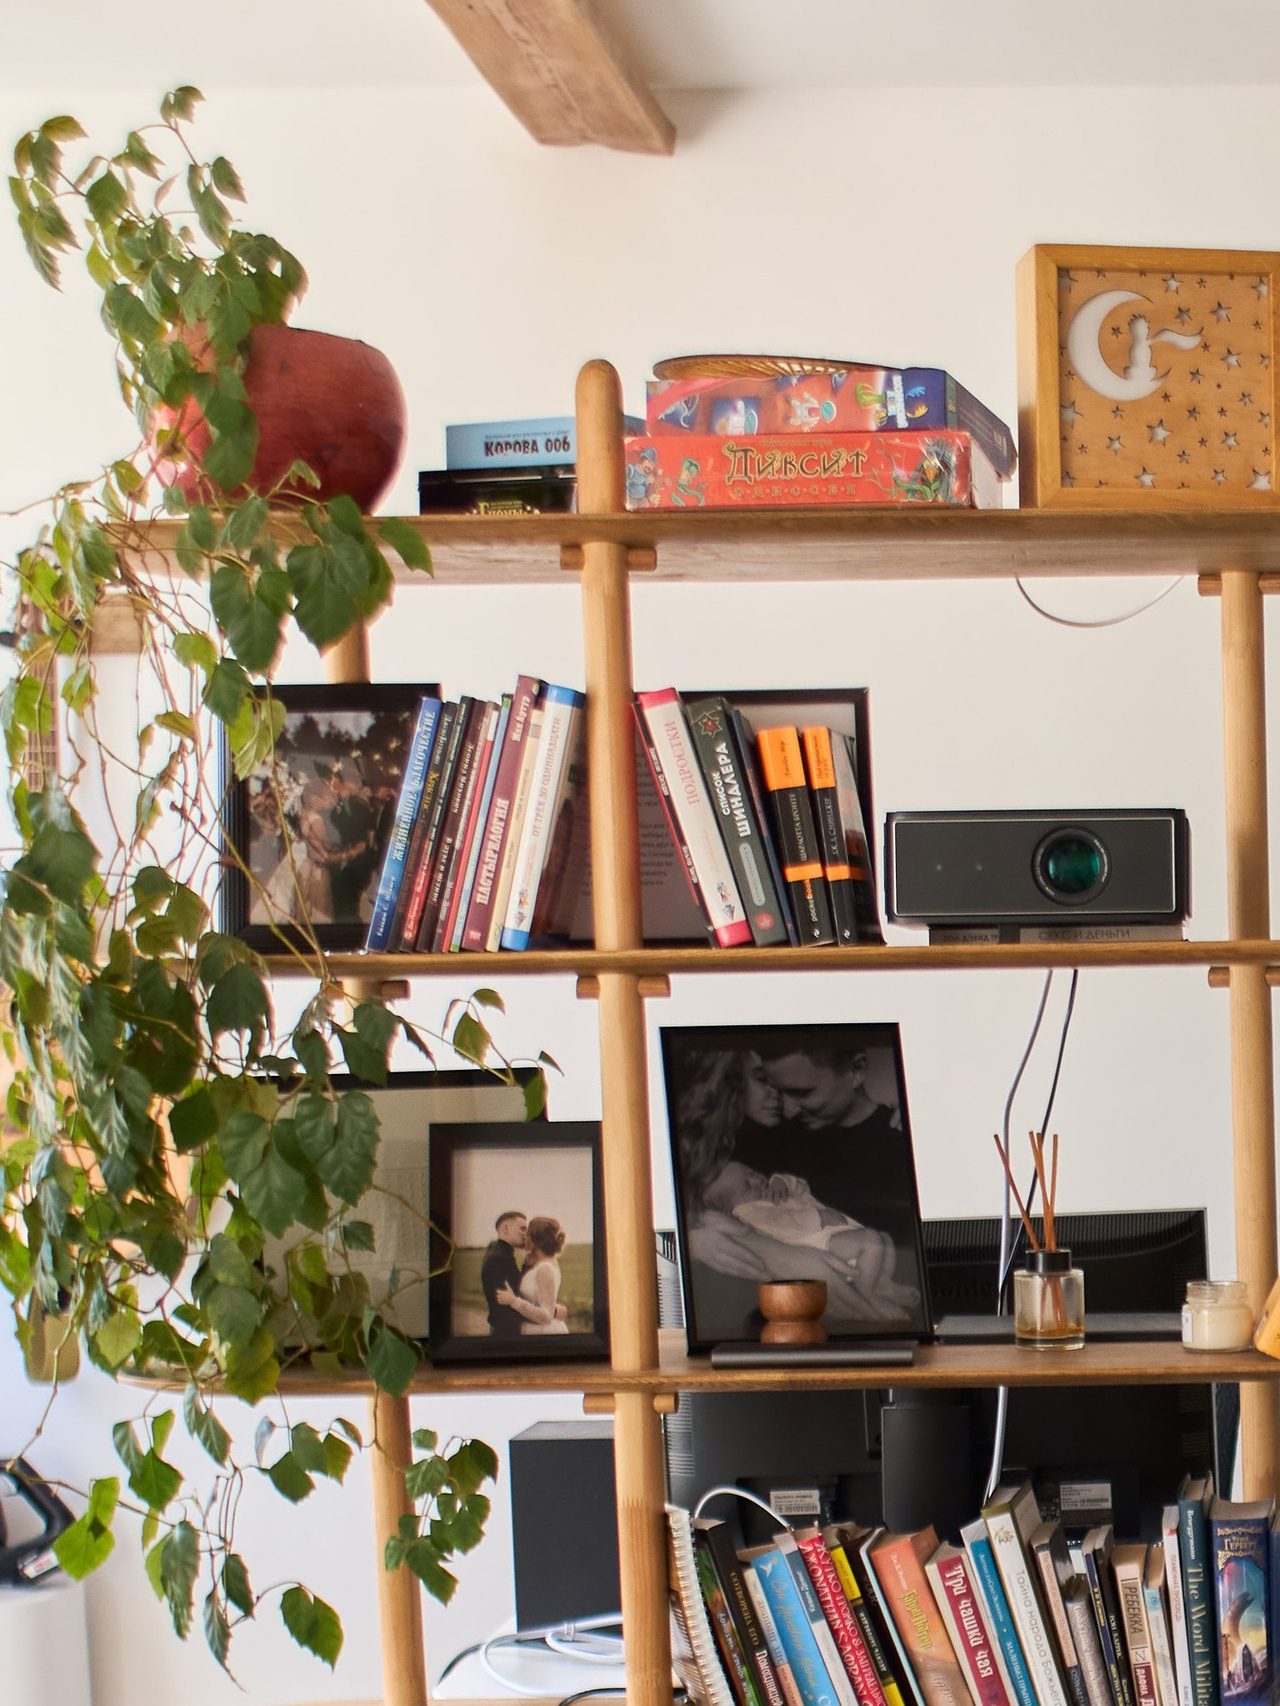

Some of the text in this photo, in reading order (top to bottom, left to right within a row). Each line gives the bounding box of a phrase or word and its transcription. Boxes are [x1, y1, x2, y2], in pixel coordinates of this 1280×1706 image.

[484, 436, 570, 456] КОРОВА 006
[516, 694, 531, 723] Артур
[392, 790, 418, 861] ЖИЗНЕННОЕ
[409, 710, 436, 786] БЛАГОЧЕСТИЕ
[531, 717, 563, 836] ОТ ДО ОДИННАДЦАТИ
[663, 719, 700, 804] ПОДРОСТКИ
[710, 771, 730, 815] СПИСОК
[713, 740, 751, 837] ШИНДЛЕРА
[472, 797, 512, 904] ПАСТЫРЕЛОГИЯ
[789, 792, 807, 861] ШАРЛОТТА БРОНТЕ
[1038, 929, 1130, 941] СЕКС И ДЕНЬГИ
[1185, 1509, 1198, 1559] Brueggemann
[728, 1572, 753, 1625] СОТВОРЕНА
[803, 1590, 816, 1612] Кевин
[814, 1540, 842, 1592] ЖУТКО
[835, 1594, 858, 1637] ГРОМКО
[851, 1636, 862, 1647] &
[1169, 1555, 1181, 1621] ПЛАМЕННАЯ ПРОПОВЕДЬ
[1186, 1563, 1205, 1599] The
[858, 1611, 877, 1648] ЗАПОВЕДЕЙ
[899, 1588, 937, 1651] Гарри Поттер
[941, 1565, 995, 1678] Три чашки чая
[1014, 1570, 1034, 1607] Тайна
[1024, 1610, 1048, 1658] народа
[1124, 1584, 1143, 1633] РЕБЕККА
[1189, 1601, 1210, 1653] Word
[731, 1652, 745, 1678] юных
[873, 1649, 886, 1672] ДЕСЯТЬ
[1135, 1667, 1148, 1695] ДАФНА
[741, 1680, 753, 1697] для
[1017, 1679, 1032, 1706] ПРЫНЦ
[1069, 1669, 1084, 1702] OSWALD
